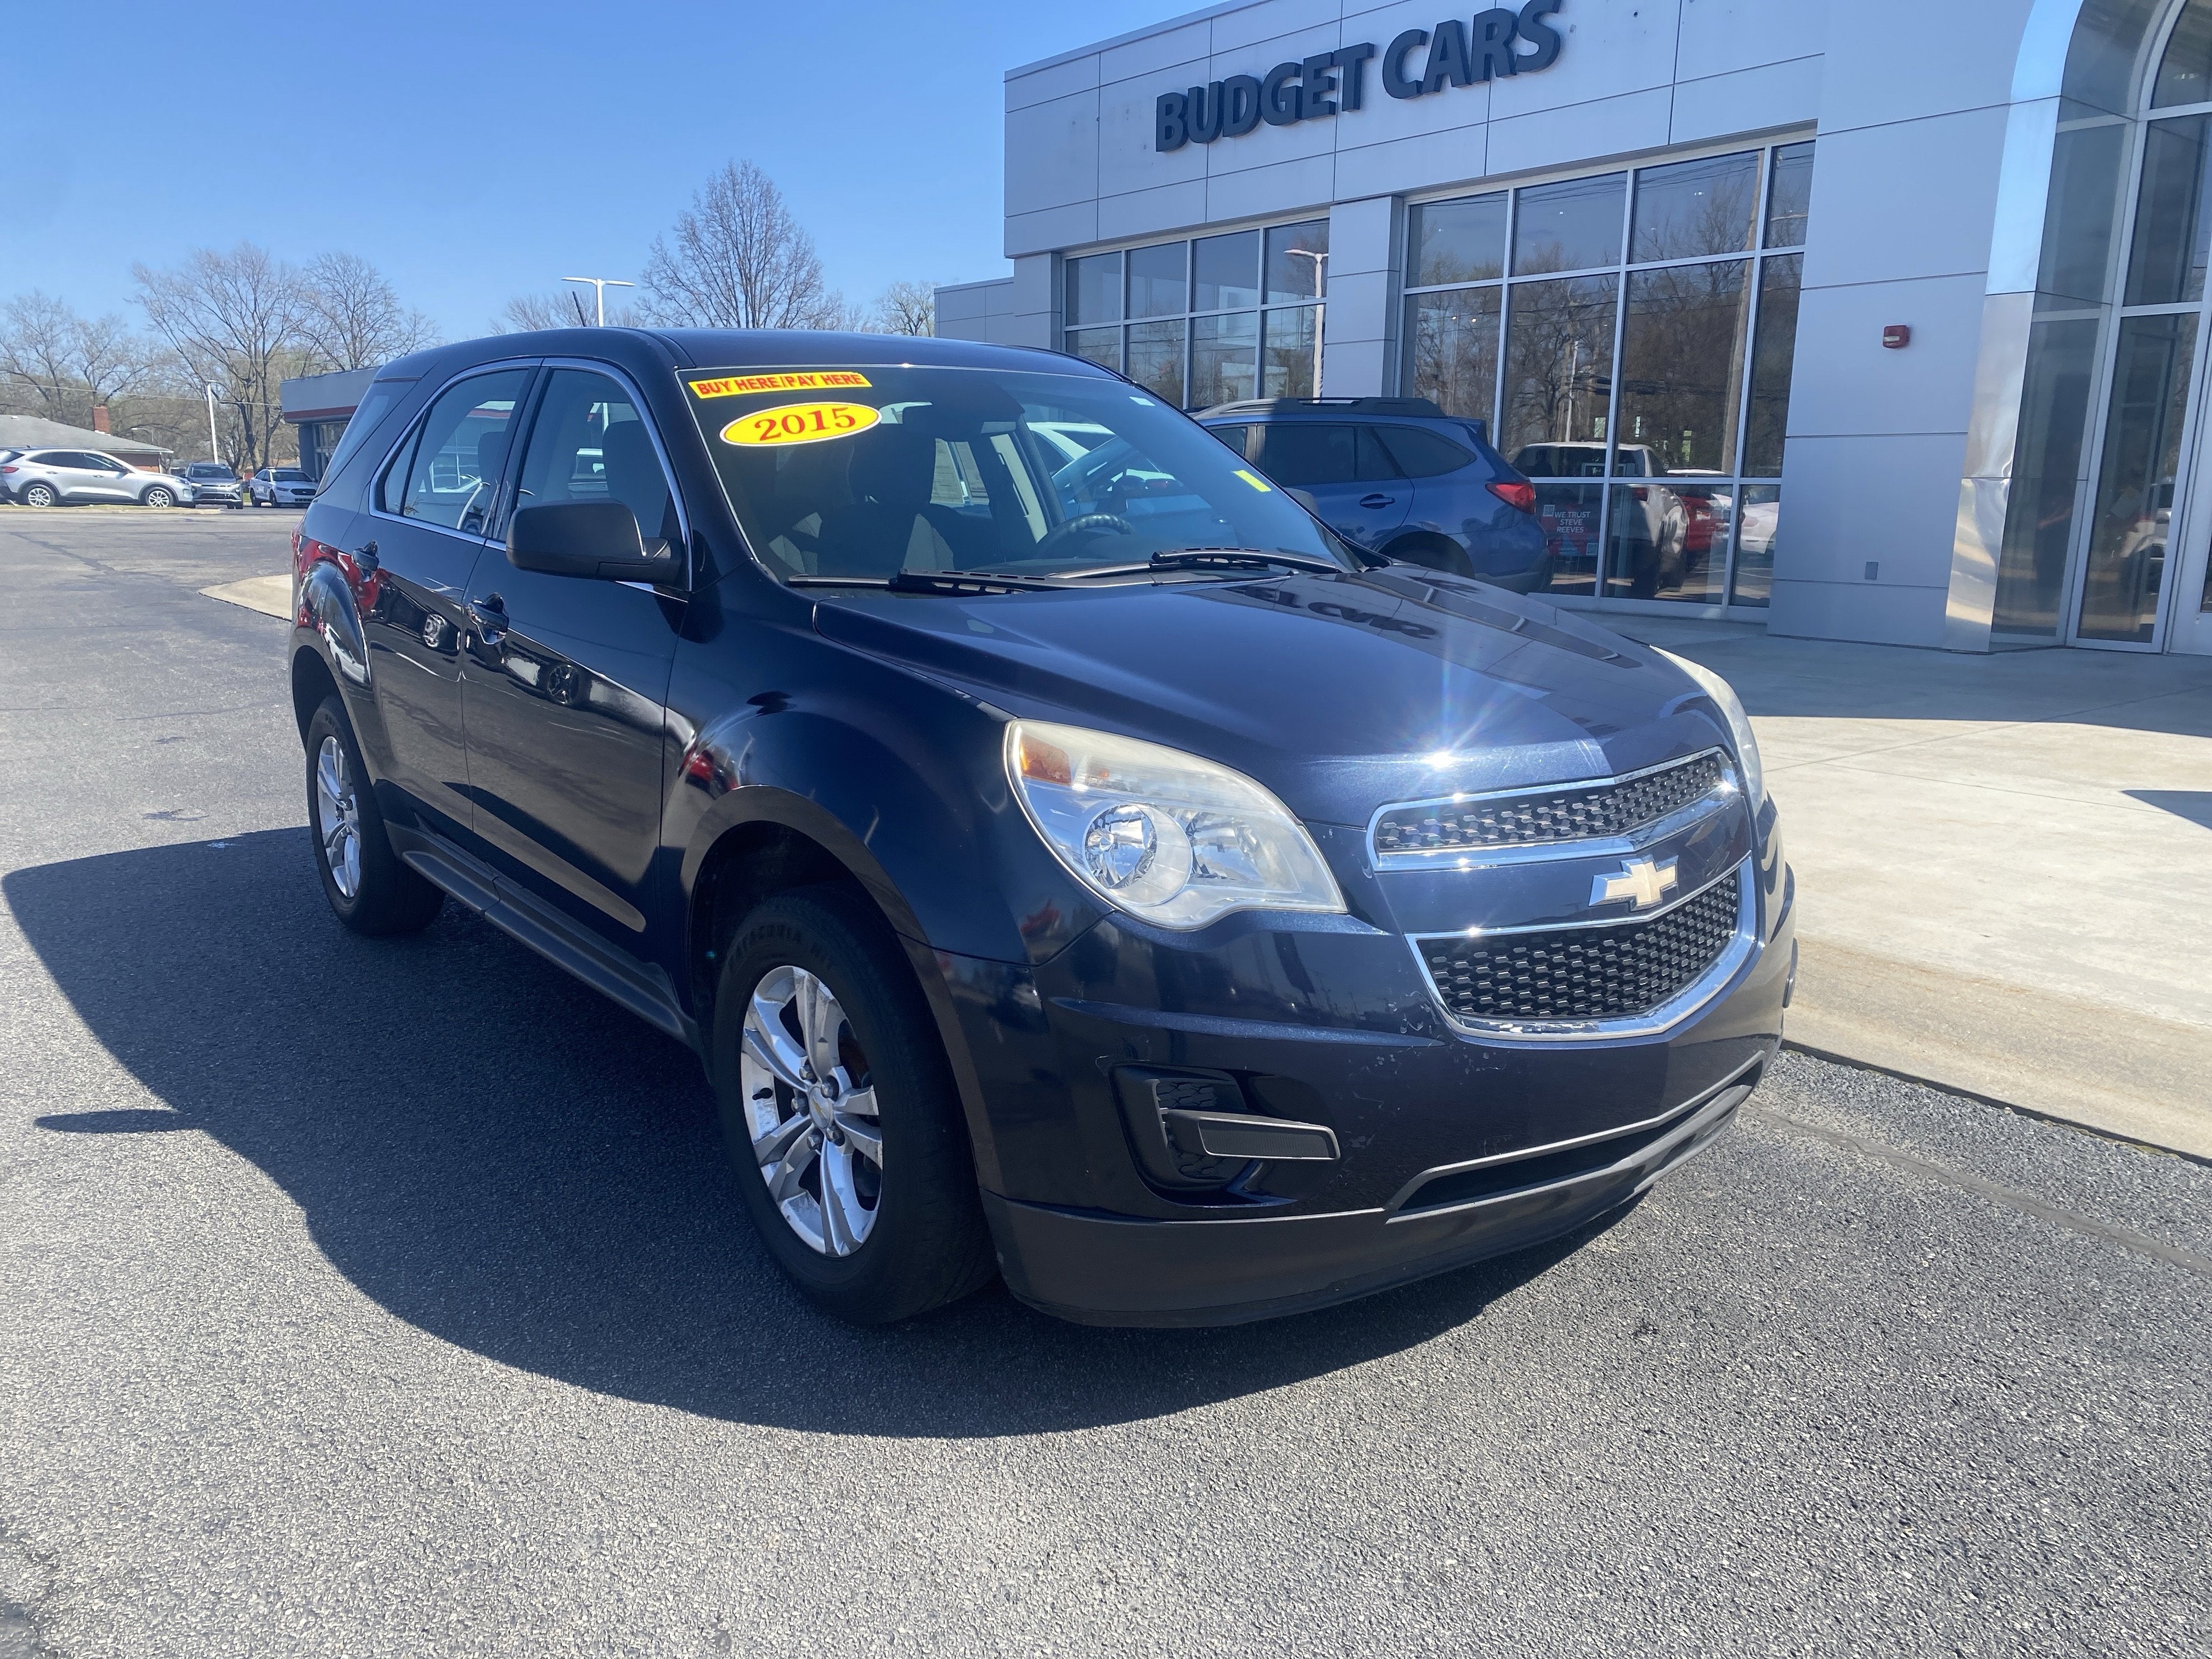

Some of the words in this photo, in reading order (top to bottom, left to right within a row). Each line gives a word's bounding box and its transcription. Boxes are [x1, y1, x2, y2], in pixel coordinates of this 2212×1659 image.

[1156, 42, 1374, 152] BUDGET
[1383, 0, 1562, 99] CARS
[697, 382, 734, 396] BUY
[821, 373, 865, 385] HERE
[755, 408, 856, 441] 2015
